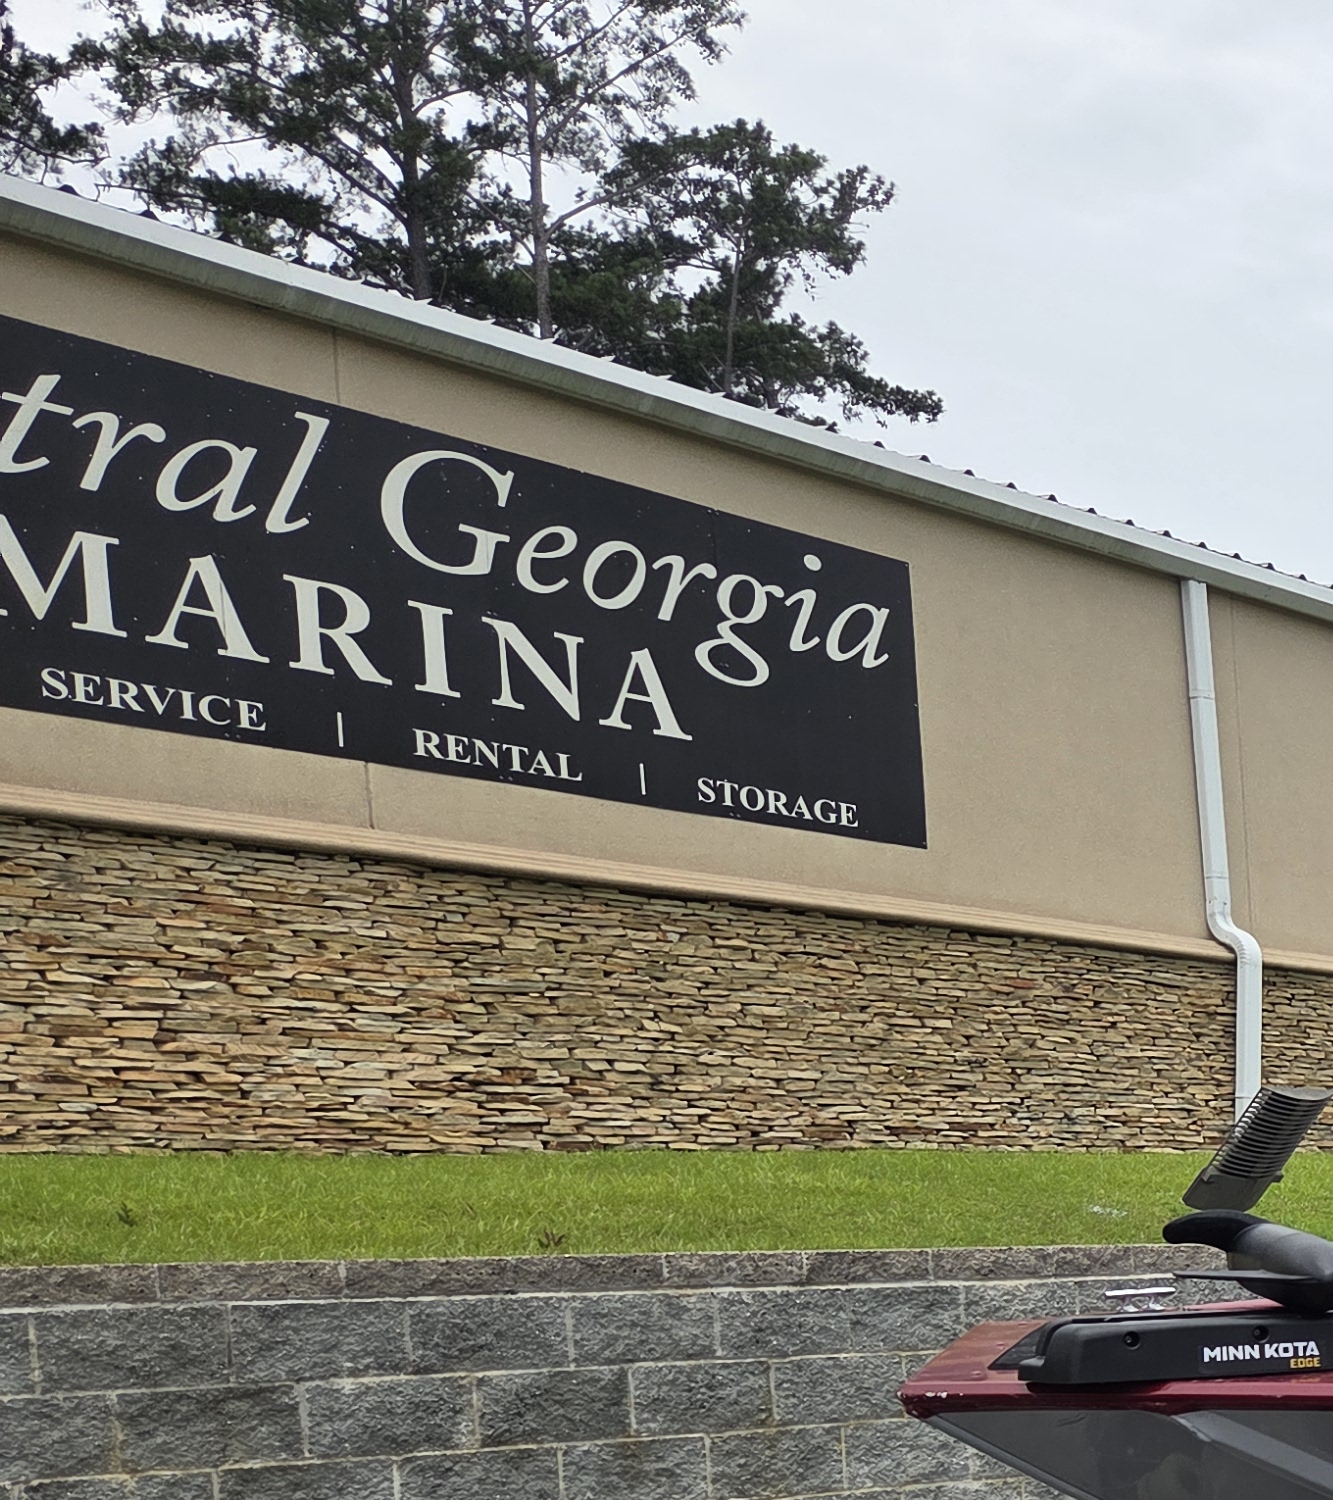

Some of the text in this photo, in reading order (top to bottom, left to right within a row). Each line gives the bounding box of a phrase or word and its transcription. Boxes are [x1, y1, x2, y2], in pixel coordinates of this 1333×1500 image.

[0, 513, 694, 741] MARINA
[380, 449, 890, 687] Georgia
[40, 667, 859, 828] SERVICE RENTAL STORAGE
[1203, 1340, 1321, 1363] MINN KOTA
[1289, 1357, 1322, 1369] EDGE
